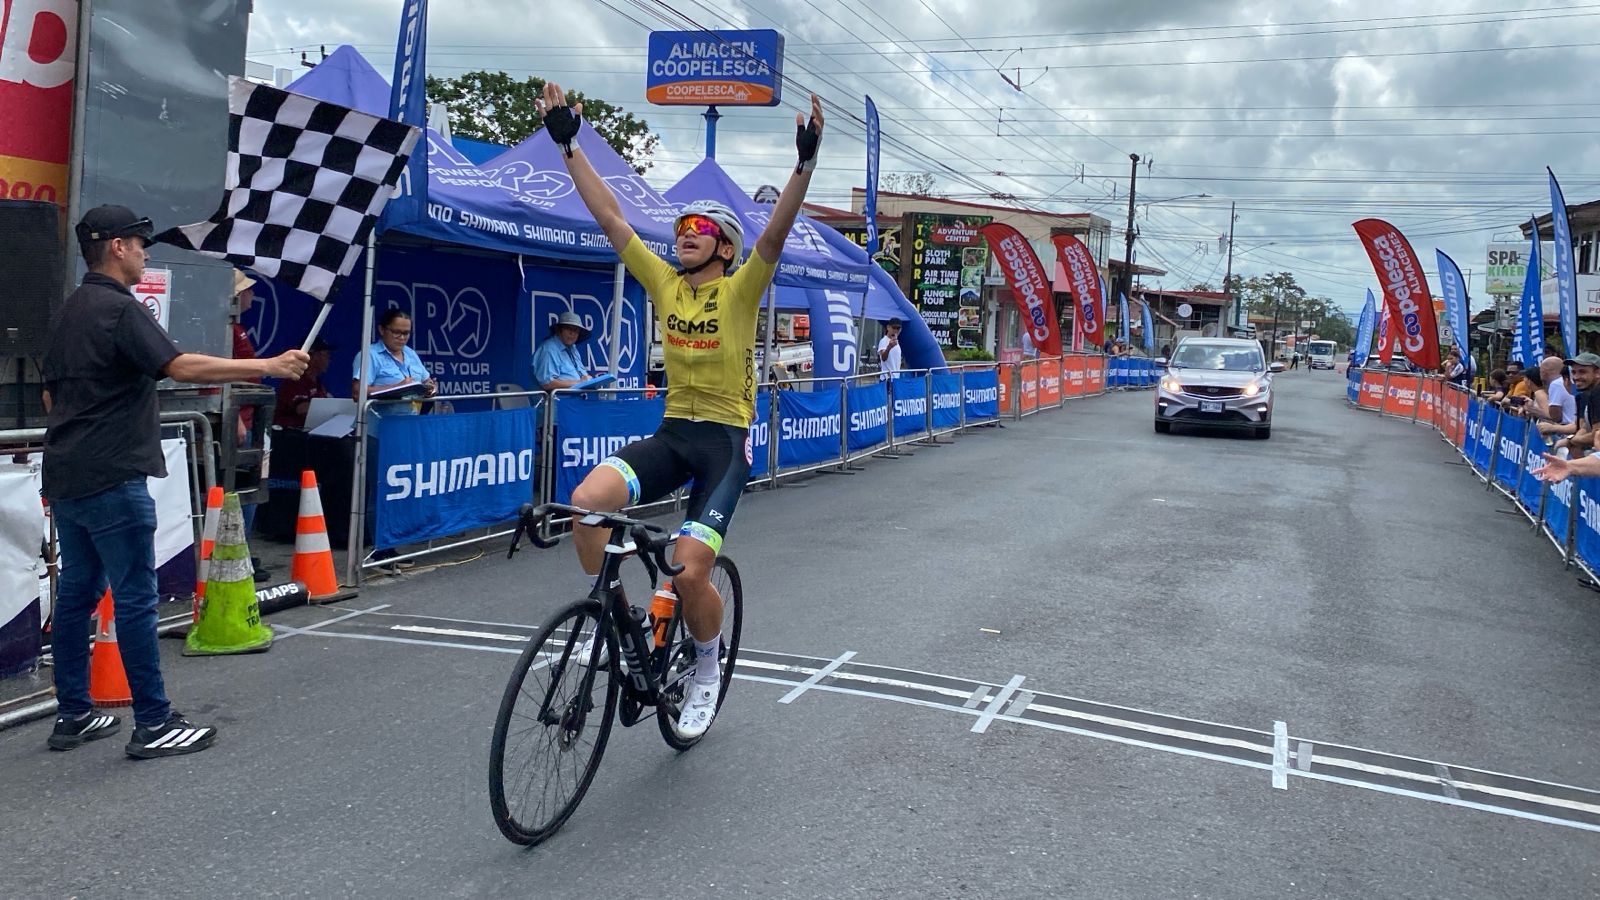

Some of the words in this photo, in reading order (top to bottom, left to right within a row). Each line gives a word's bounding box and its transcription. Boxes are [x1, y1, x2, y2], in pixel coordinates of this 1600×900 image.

[669, 42, 755, 59] ALMACEN
[653, 59, 770, 76] COOPELESCA
[667, 85, 735, 95] COOPELESCA
[459, 210, 519, 237] SHIMANO
[523, 224, 576, 245] SHIMANO
[580, 233, 614, 248] SHIMA
[937, 228, 978, 236] ADVENTURE
[945, 235, 970, 243] CENTER
[925, 249, 951, 258] SLOTH
[1489, 251, 1518, 265] SPA
[924, 257, 947, 265] PARK
[1012, 234, 1044, 289] ALMACENES
[1387, 231, 1422, 294] ALMACENES
[924, 269, 938, 278] AIR
[940, 270, 959, 278] TIME
[924, 277, 958, 285] ZIP-LINE
[923, 290, 954, 298] JUNGLE
[923, 297, 944, 305] TOUR
[667, 334, 720, 349] Telecable
[450, 362, 490, 376] YOUR
[617, 377, 639, 389] OUR
[965, 386, 997, 404] SHIMANO
[894, 397, 927, 417] SHIMAN
[851, 405, 888, 432] SHIMAN
[782, 413, 840, 440] SHIMANO
[386, 449, 533, 501] SHIMANO
[256, 583, 299, 601] YLAPS
